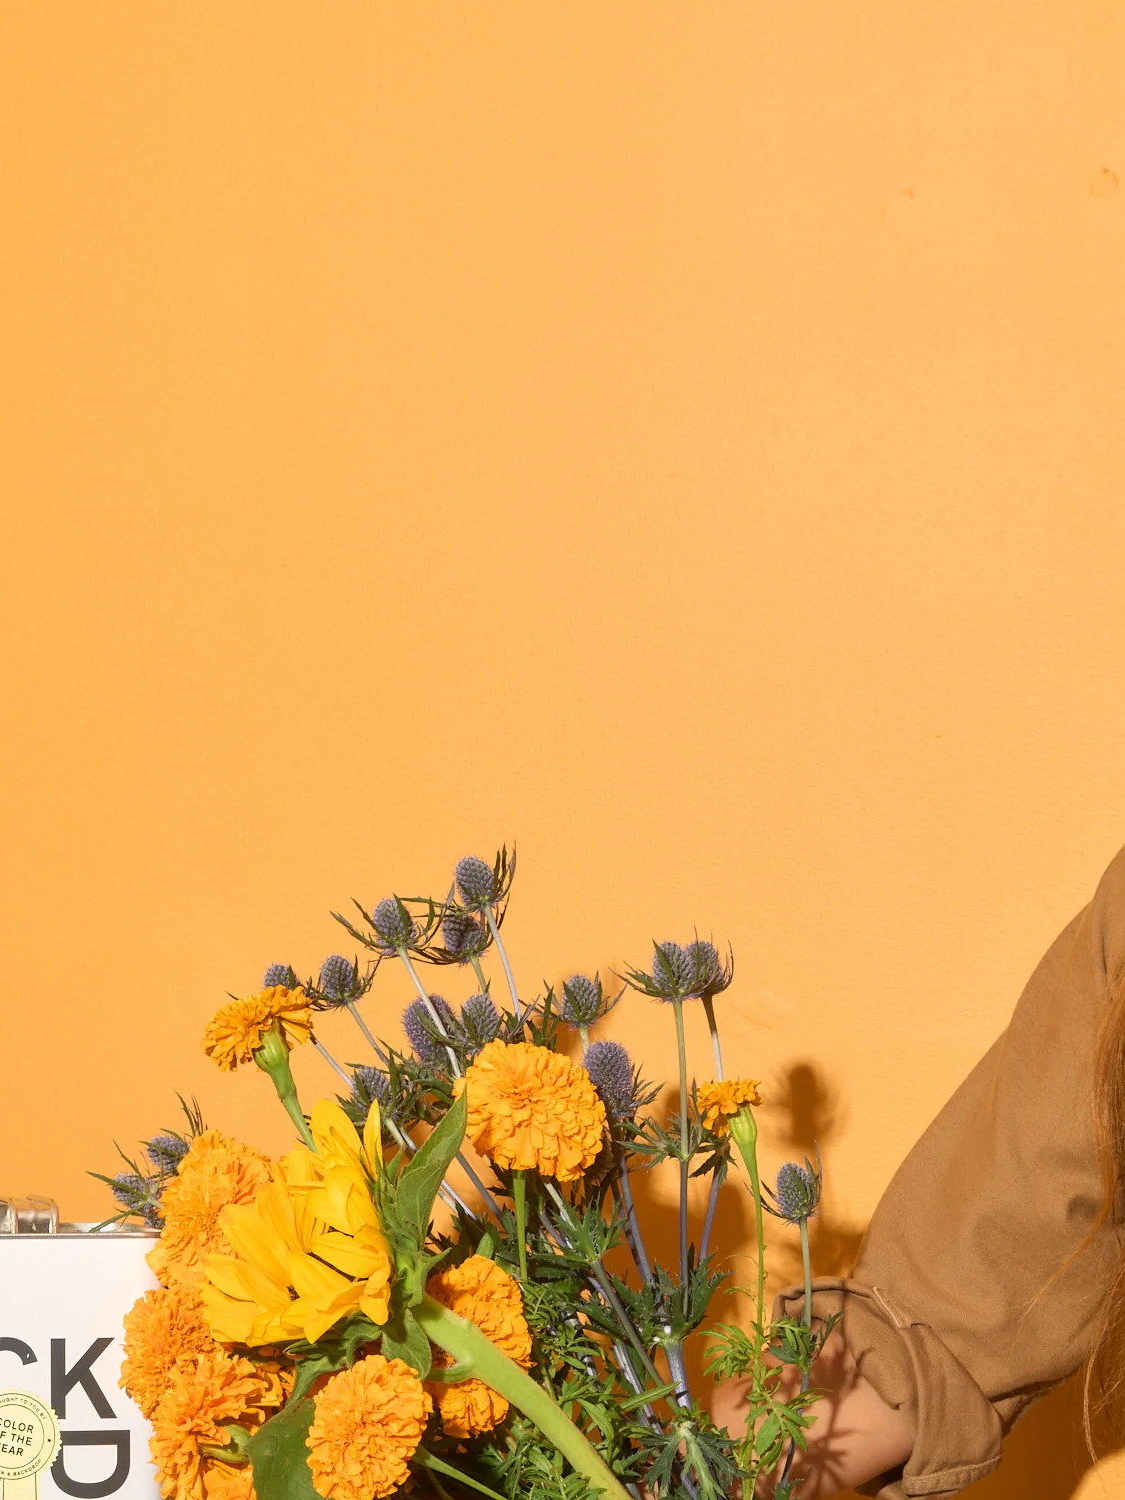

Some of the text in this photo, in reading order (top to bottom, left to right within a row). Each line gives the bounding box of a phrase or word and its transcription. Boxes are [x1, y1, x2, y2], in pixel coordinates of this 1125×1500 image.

[29, 1403, 40, 1412] YOU
[39, 1412, 46, 1420] BY
[11, 1433, 32, 1446] THE
[12, 1458, 42, 1476] BACKDROP
